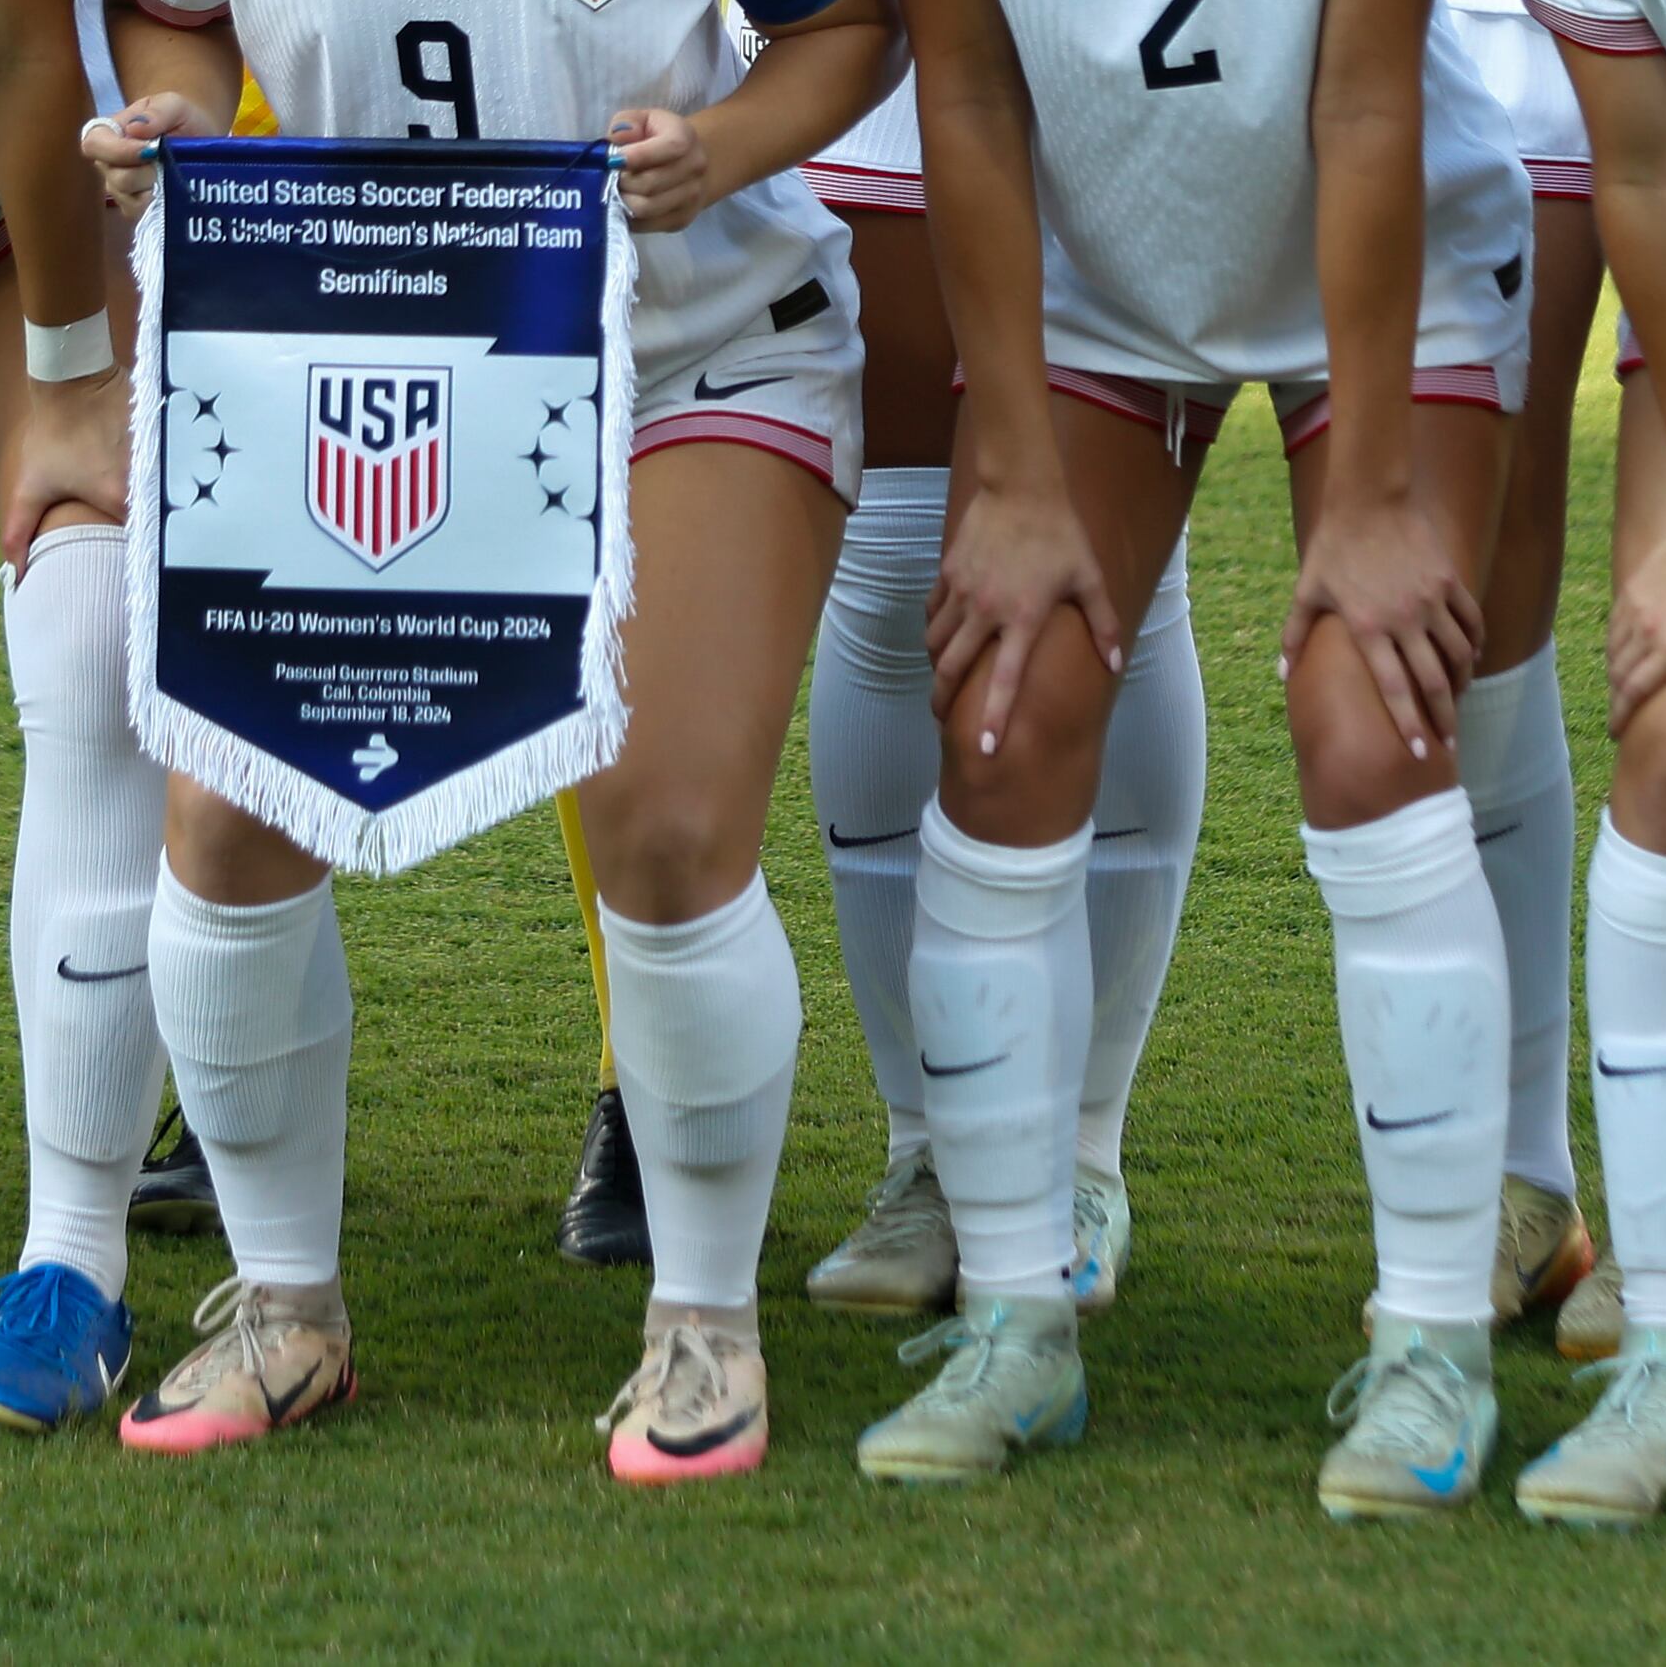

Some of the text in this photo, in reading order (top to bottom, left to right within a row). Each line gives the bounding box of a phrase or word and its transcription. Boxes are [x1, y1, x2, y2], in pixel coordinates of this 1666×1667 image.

[394, 20, 480, 139] 9
[189, 178, 582, 210] United States Soccer Federation
[188, 216, 583, 249] U.S. Under-20 Women's National Team
[319, 267, 448, 295] Semifinals
[318, 377, 440, 452] USA
[205, 609, 552, 642] FIFA U-20 Women's World Cup 2024
[275, 662, 479, 685] Pascual Guerrero Stadium
[322, 684, 431, 703] Cali, Colombia
[300, 703, 452, 725] September 18, 2024
